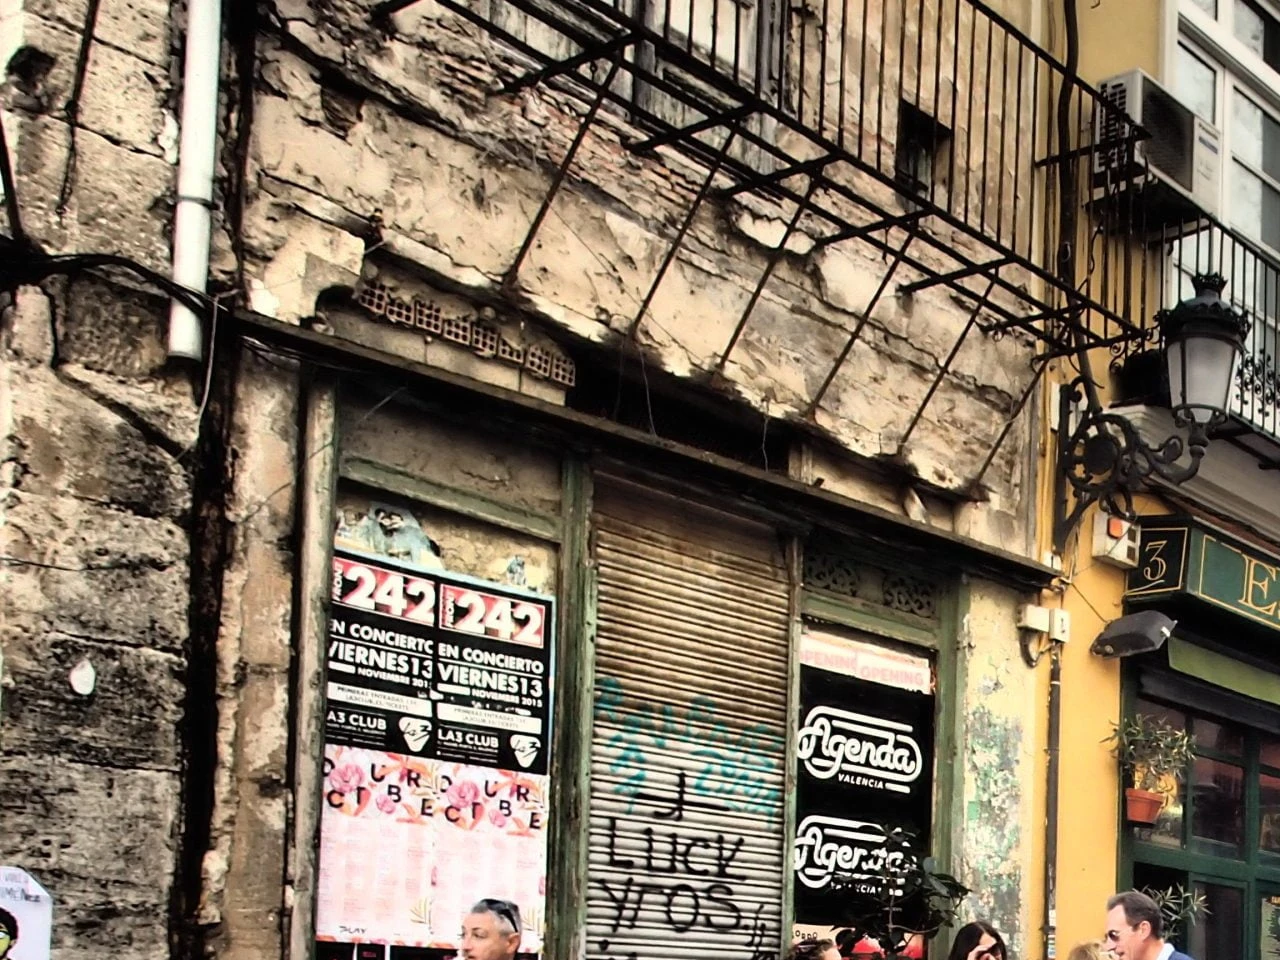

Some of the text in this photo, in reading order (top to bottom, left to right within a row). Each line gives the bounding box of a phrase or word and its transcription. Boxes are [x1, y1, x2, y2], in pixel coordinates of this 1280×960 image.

[1144, 540, 1168, 581] 3
[342, 566, 435, 627] 242
[454, 593, 543, 647] 242
[411, 657, 433, 679] 13
[438, 643, 544, 674] EN CONCIERTO
[437, 663, 543, 697] VIERNES 13
[861, 665, 924, 686] OPENING
[521, 697, 543, 708] 2015
[327, 710, 346, 723] A3
[349, 714, 387, 730] CLUB
[438, 729, 462, 743] LA3
[465, 733, 499, 748] CLUB
[797, 716, 917, 779] Agenda
[838, 773, 884, 790] VALENCIA
